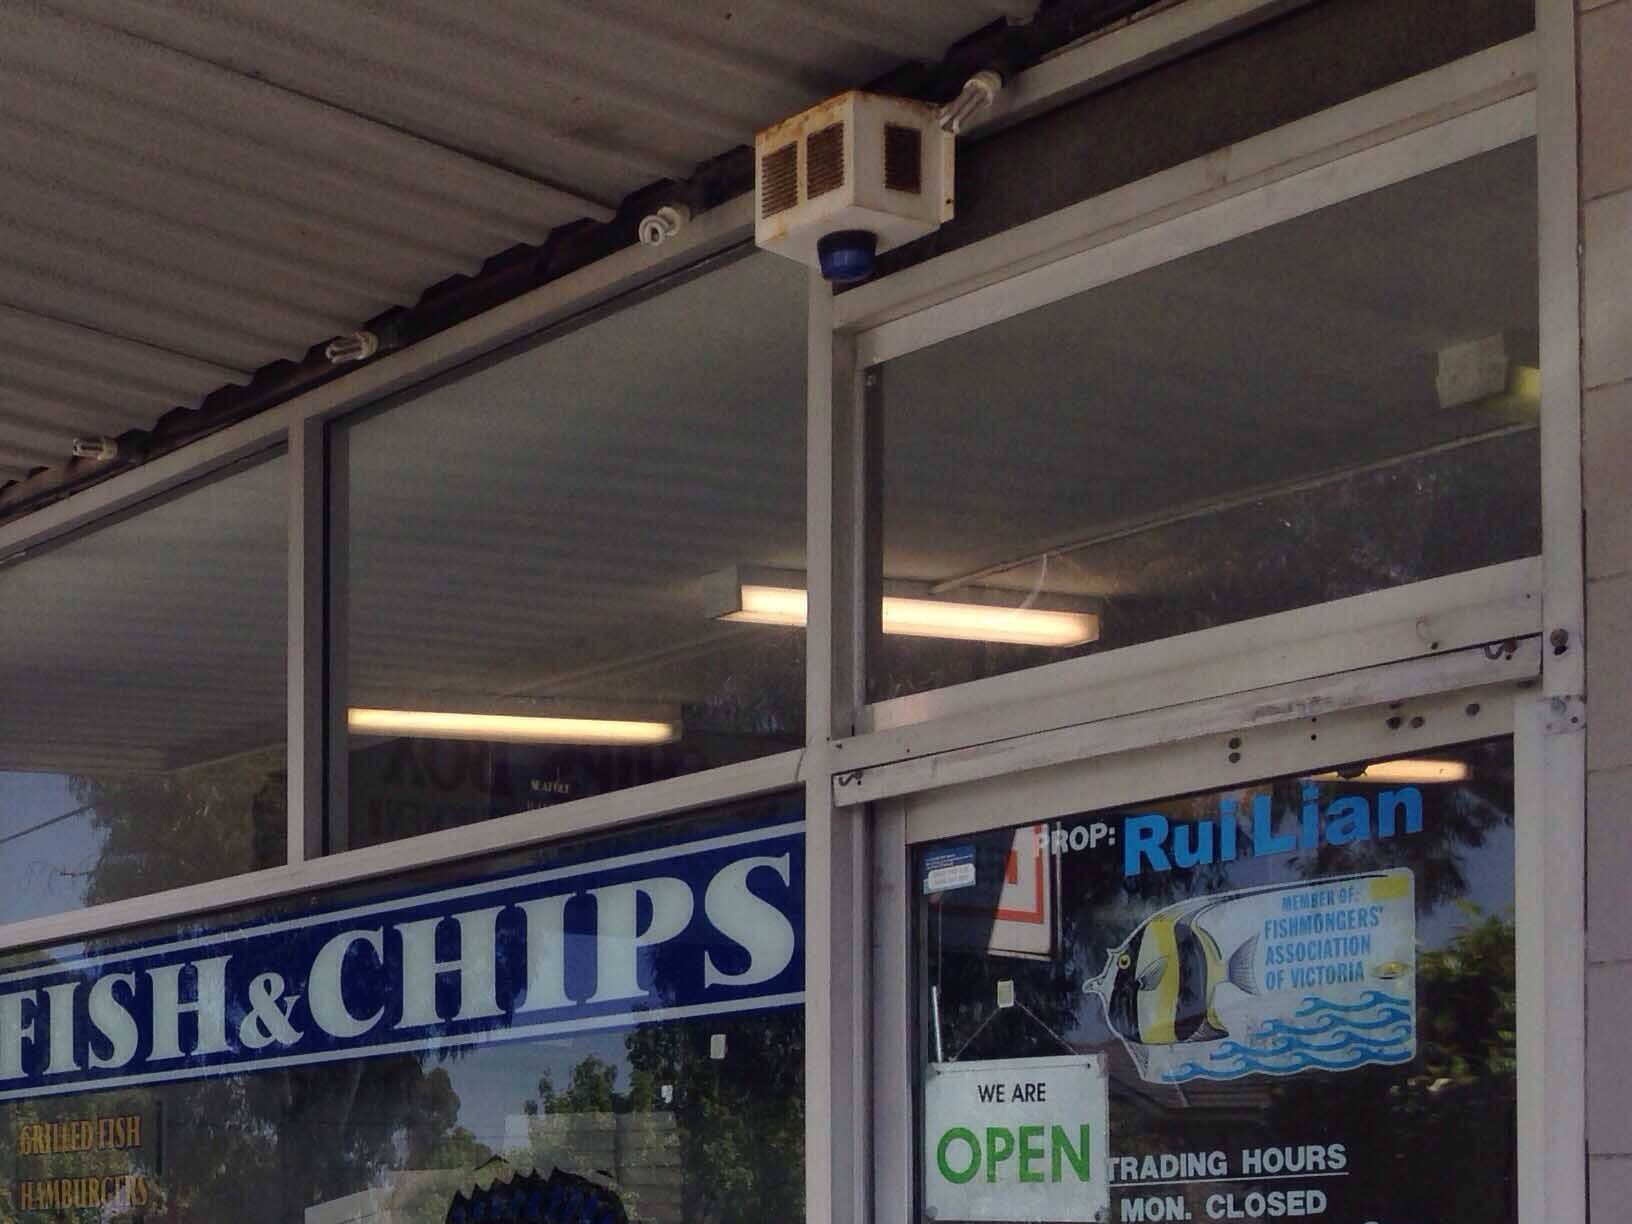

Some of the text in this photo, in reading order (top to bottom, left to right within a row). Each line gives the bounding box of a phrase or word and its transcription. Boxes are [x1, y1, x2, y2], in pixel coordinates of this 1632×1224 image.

[1036, 784, 1423, 876] PROP: Rui Lian
[1282, 887, 1355, 912] MEMBER OF
[1264, 905, 1384, 939] FISHMONGERS'
[1265, 934, 1371, 966] ASSOCIATION
[1265, 961, 1365, 991] OF VICTORIA
[978, 1082, 1046, 1103] WE ARE
[96, 1115, 141, 1149] FISH
[936, 1123, 1091, 1185] OPEN
[1109, 1144, 1347, 1182] TRADING HOURS
[1120, 1190, 1327, 1223] MON. CLOSED
